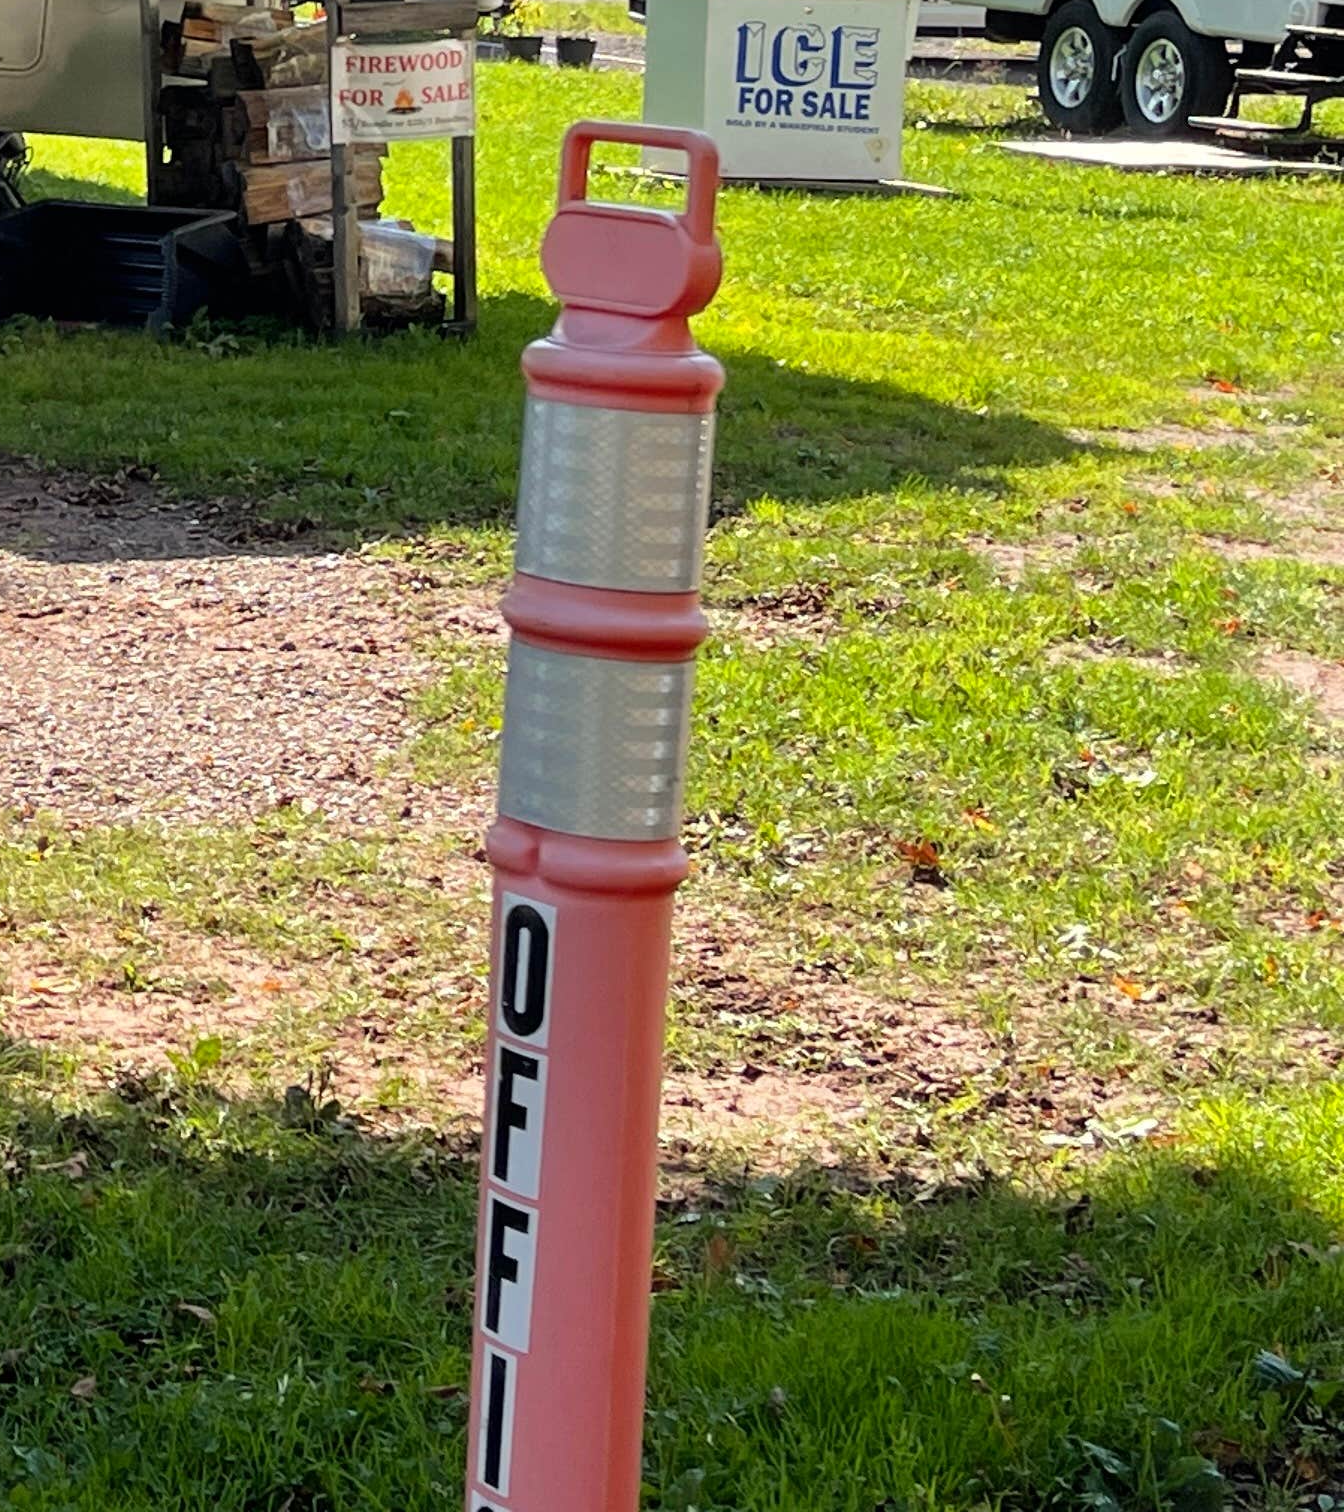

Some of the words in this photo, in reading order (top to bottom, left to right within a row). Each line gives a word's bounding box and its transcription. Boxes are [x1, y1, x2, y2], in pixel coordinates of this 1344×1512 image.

[345, 50, 462, 74] FIREWOOD
[736, 21, 880, 90] ICE
[339, 88, 384, 108] FOR
[421, 82, 470, 105] SALE
[738, 87, 793, 116] FOR
[801, 90, 871, 120] SALE
[769, 121, 778, 129] A
[477, 904, 549, 1512] OFFI
